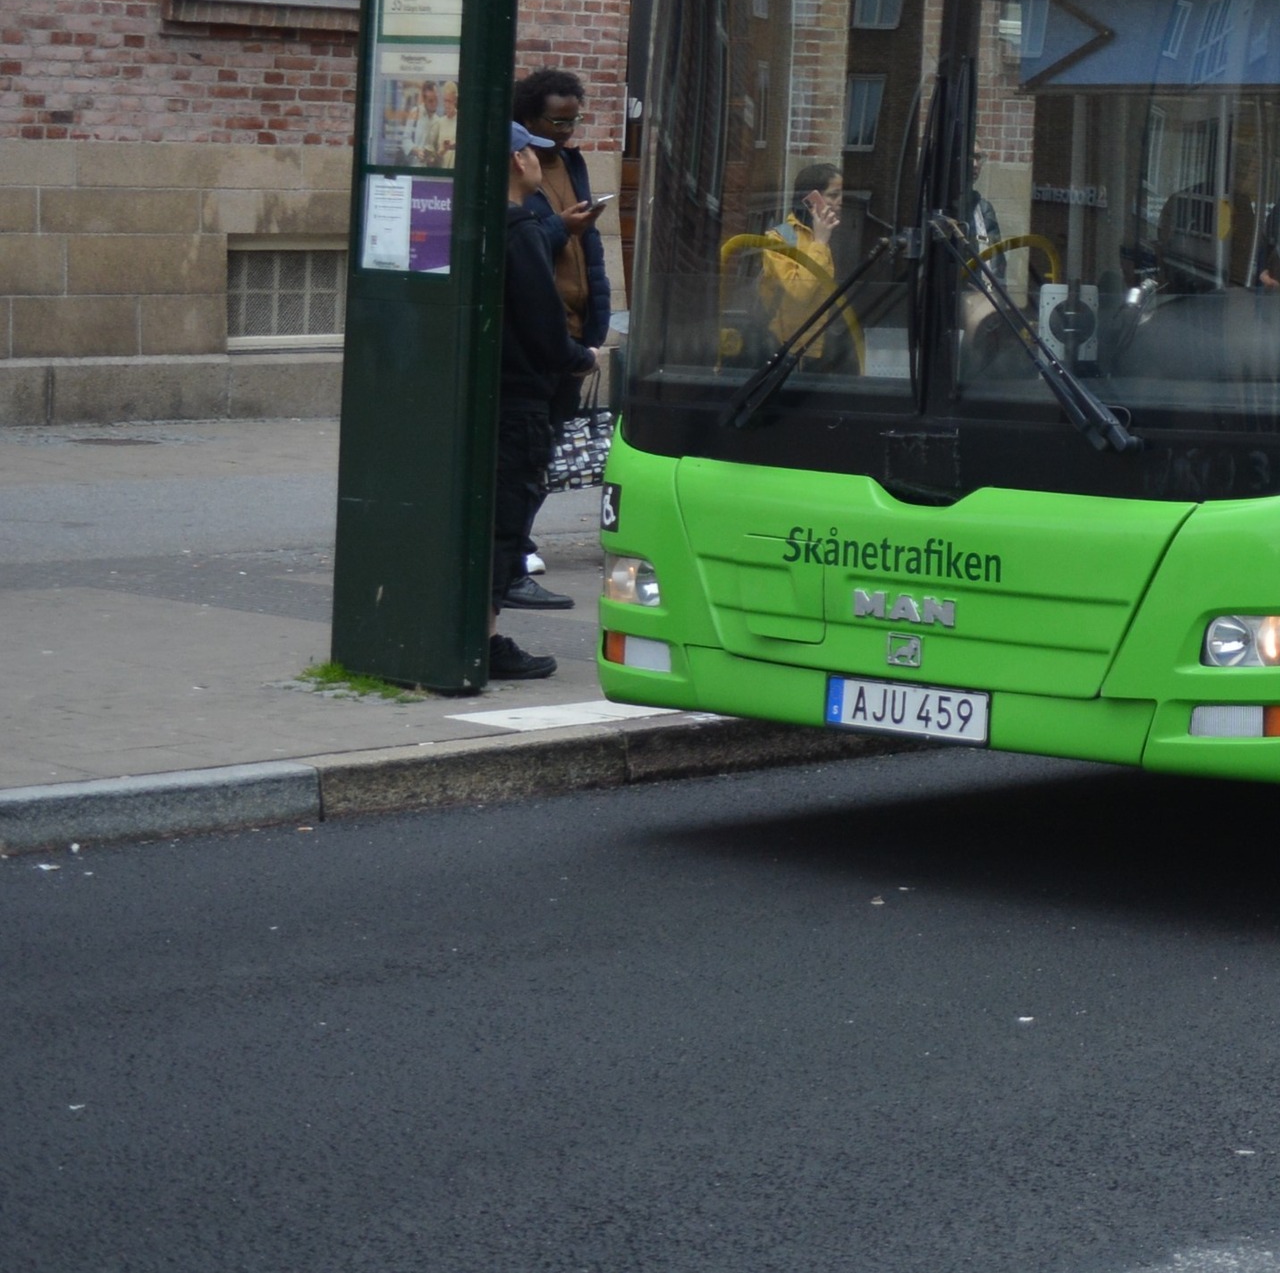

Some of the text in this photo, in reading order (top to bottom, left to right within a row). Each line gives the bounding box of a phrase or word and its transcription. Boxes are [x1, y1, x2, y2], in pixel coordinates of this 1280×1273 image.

[783, 525, 1002, 584] Skånetrafiken
[853, 588, 957, 628] MAN
[832, 705, 839, 715] S
[852, 686, 974, 733] AJU 459
